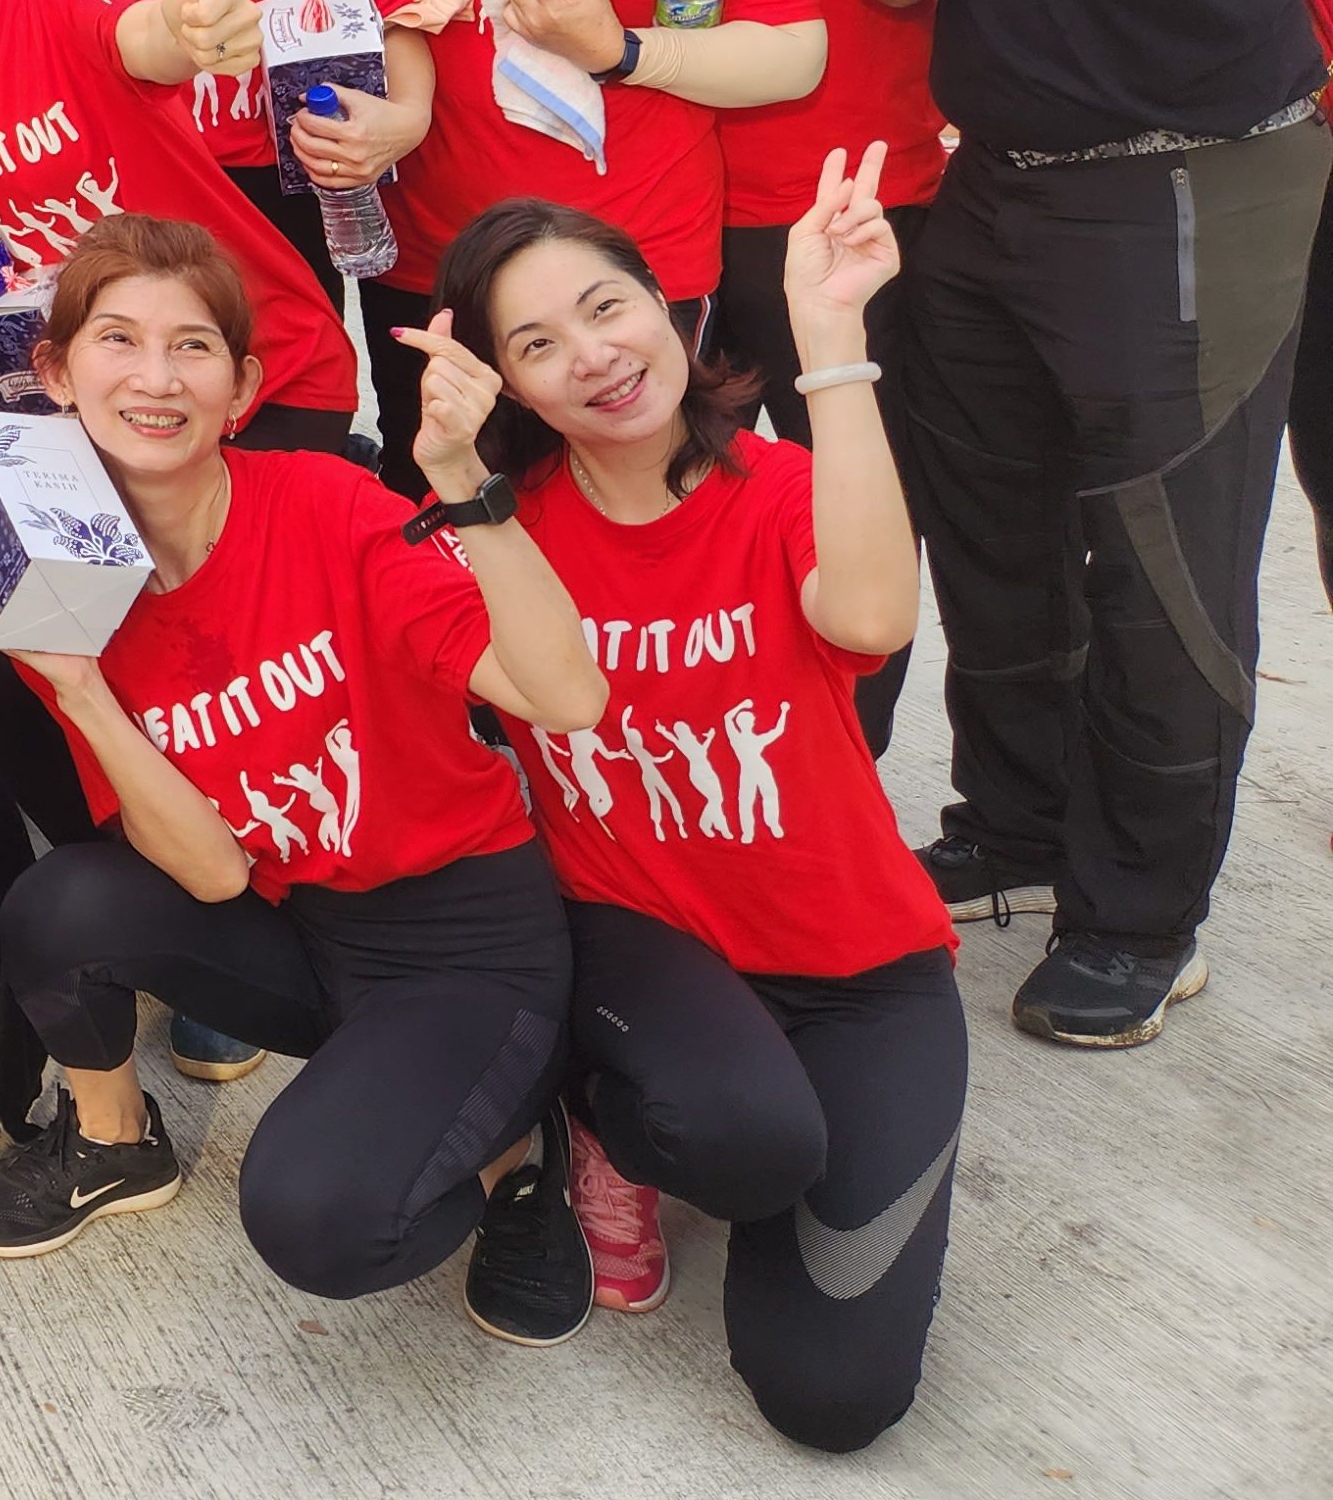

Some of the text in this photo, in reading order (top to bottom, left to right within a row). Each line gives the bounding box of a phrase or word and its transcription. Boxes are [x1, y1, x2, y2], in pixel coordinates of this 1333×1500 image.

[16, 101, 80, 163] OUT
[23, 470, 79, 483] TERIMA
[34, 480, 78, 491] KASIH
[636, 619, 676, 673] IT
[684, 602, 755, 668] OUT
[220, 675, 261, 736] IT
[259, 630, 346, 712] OUT
